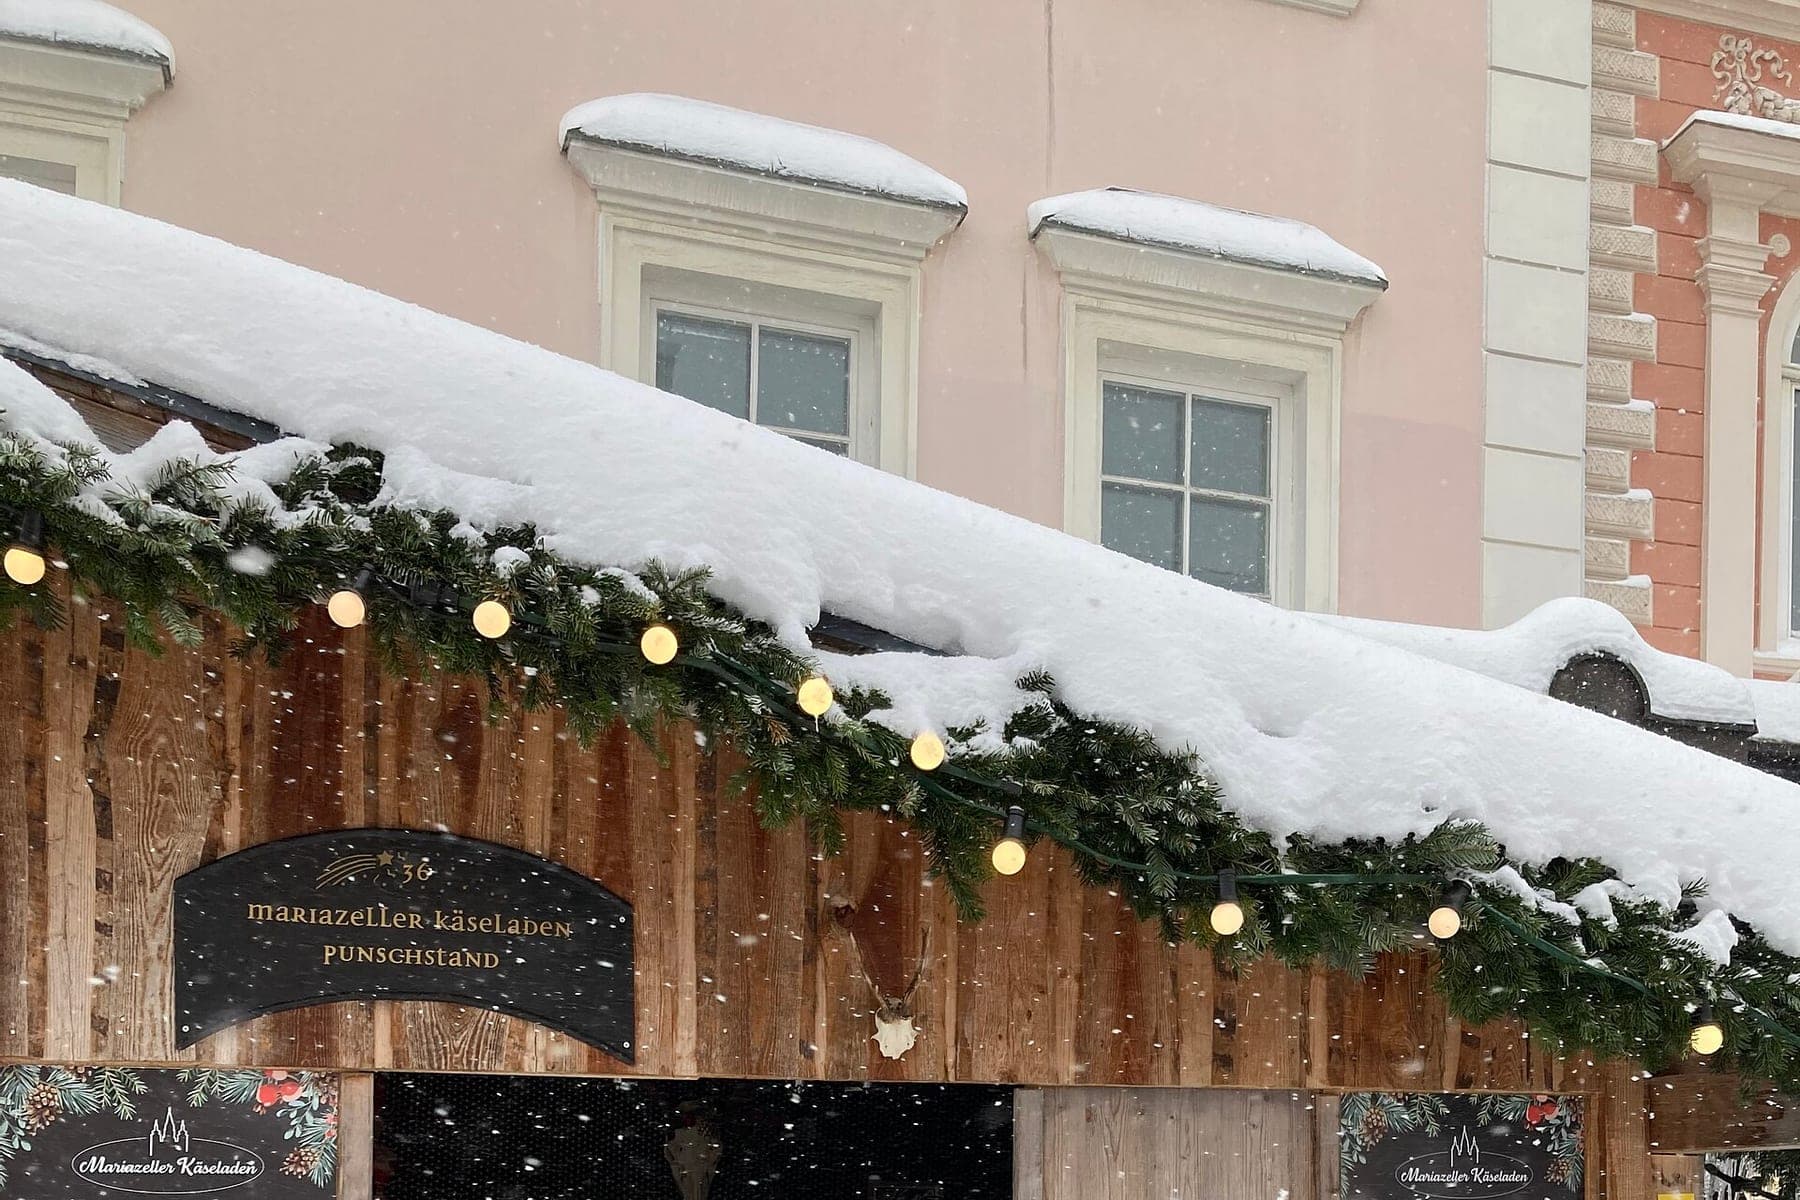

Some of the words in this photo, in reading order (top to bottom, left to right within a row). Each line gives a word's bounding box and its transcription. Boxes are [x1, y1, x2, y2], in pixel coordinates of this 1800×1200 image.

[403, 862, 431, 884] 36
[79, 1156, 175, 1175] Mariazeller
[177, 1156, 258, 1176] Käseladen
[1400, 1167, 1470, 1183] Mariazeller
[1471, 1166, 1528, 1183] Käseladen
